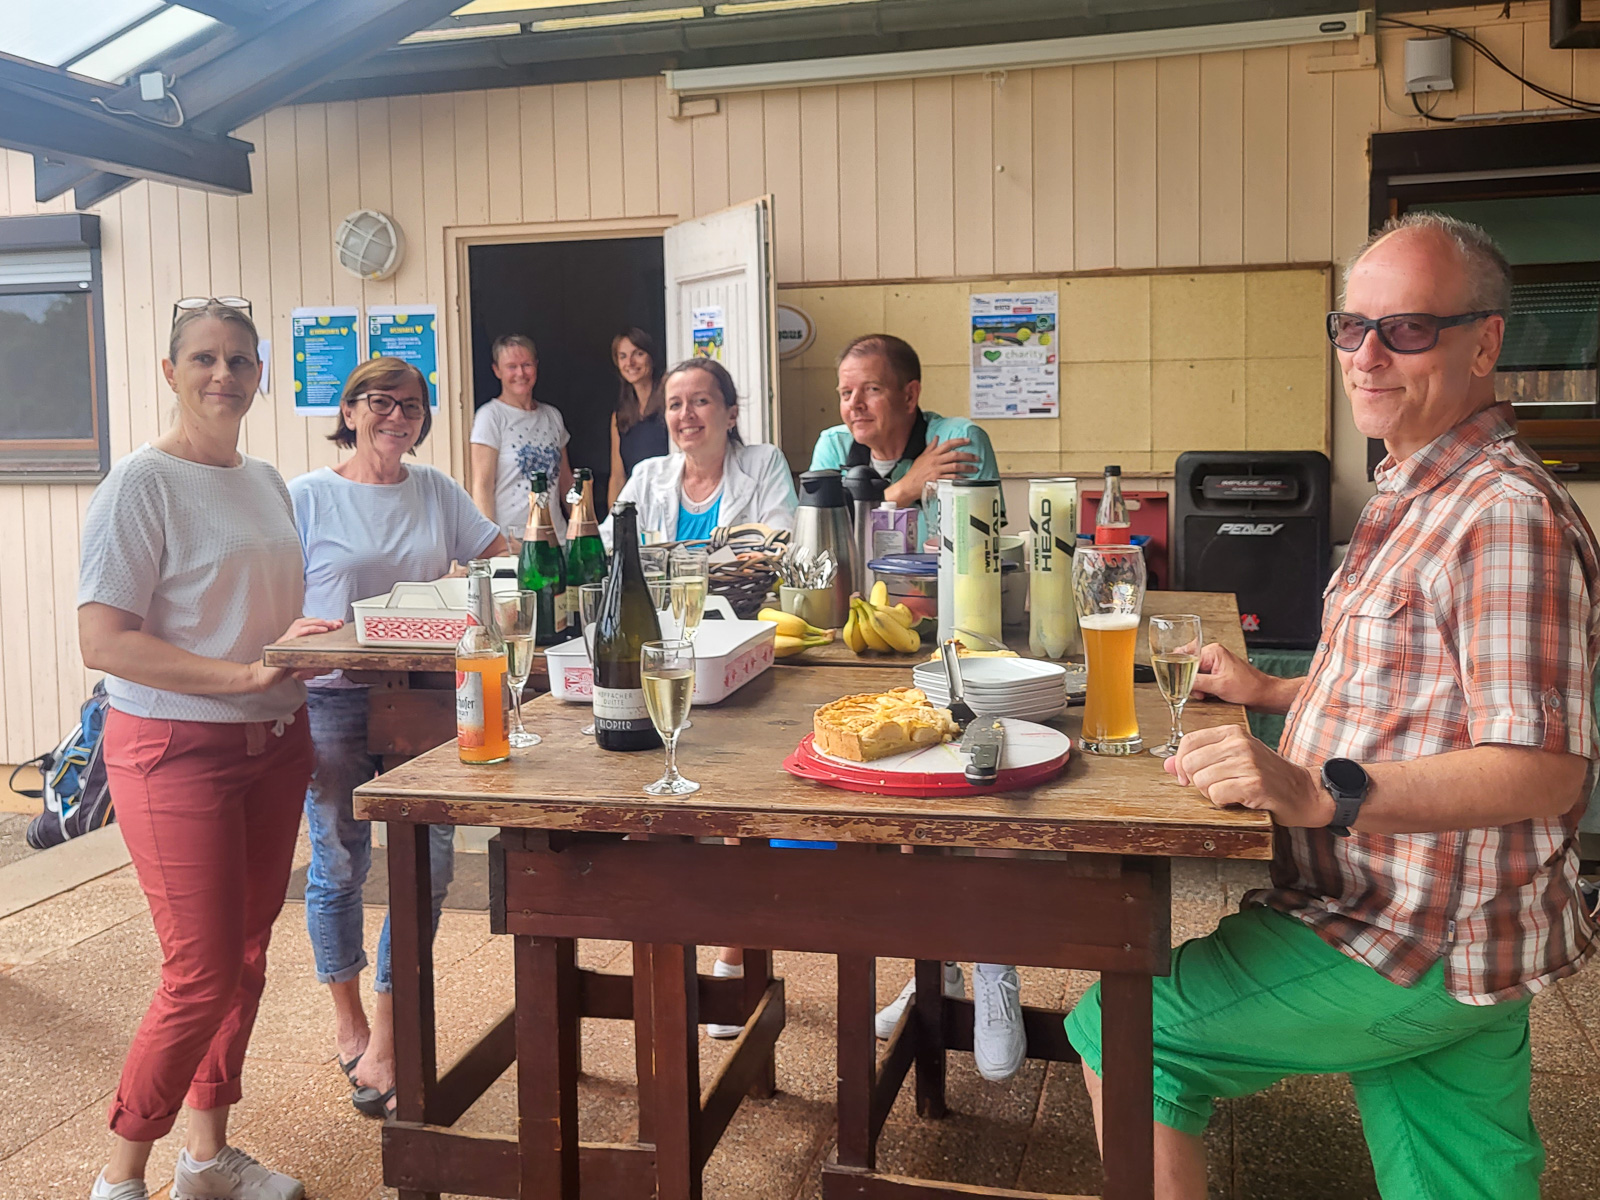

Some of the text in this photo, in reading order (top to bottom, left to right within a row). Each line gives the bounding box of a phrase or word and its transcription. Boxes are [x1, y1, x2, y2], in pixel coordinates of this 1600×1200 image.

[1005, 348, 1044, 360] charity
[992, 499, 1000, 573] HEAD
[1041, 498, 1052, 572] HEAD
[1216, 523, 1285, 536] PEAVEY
